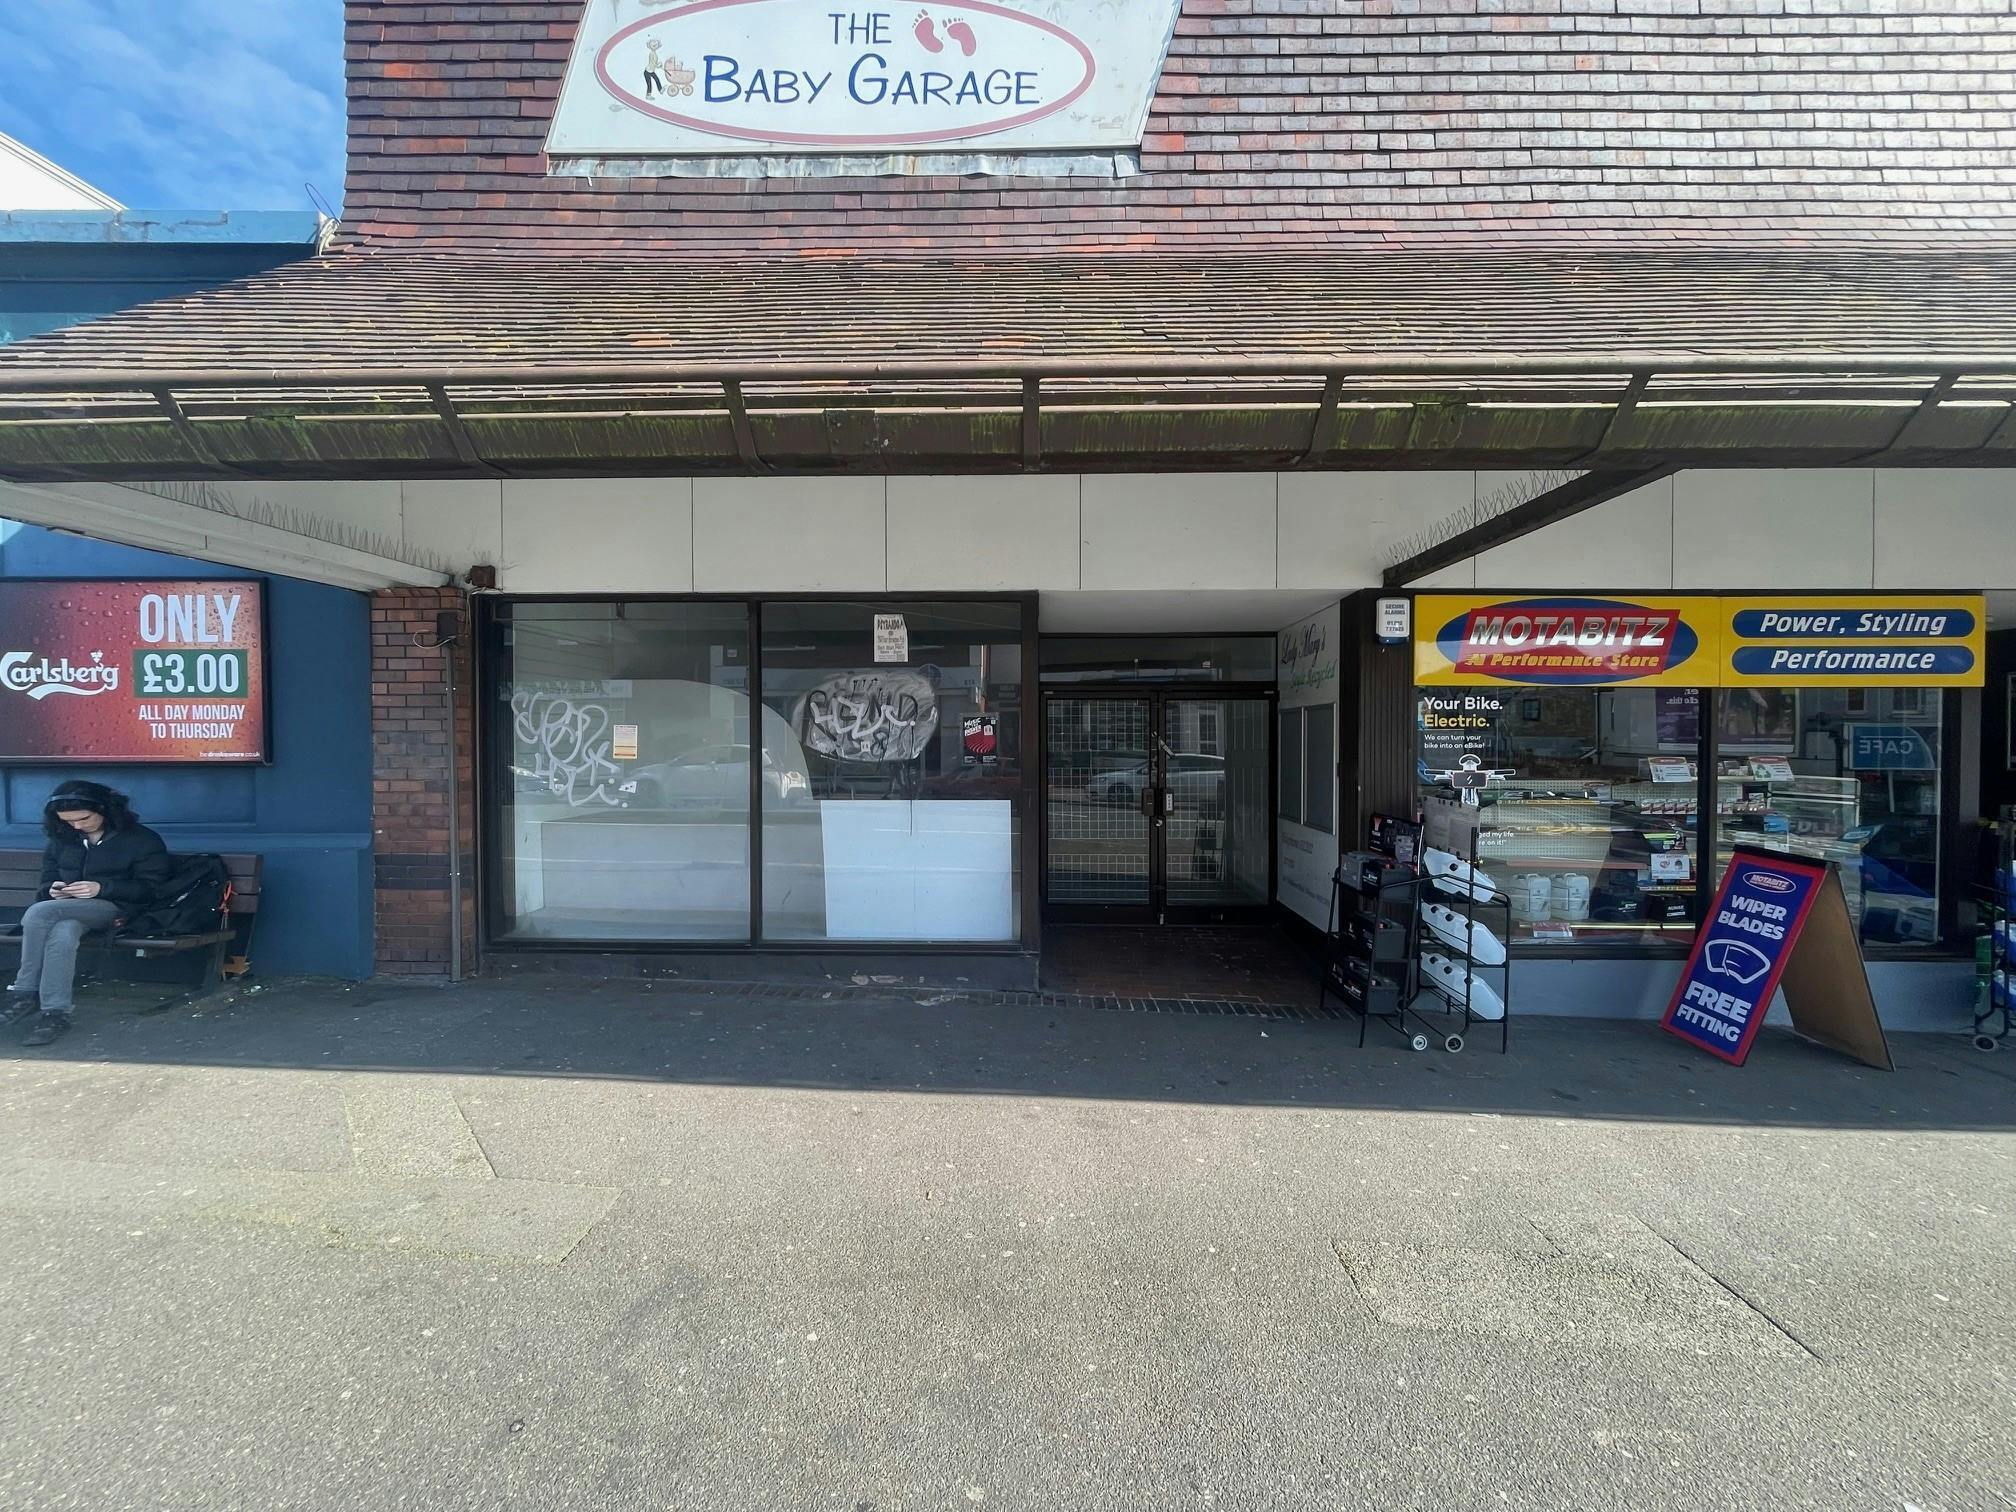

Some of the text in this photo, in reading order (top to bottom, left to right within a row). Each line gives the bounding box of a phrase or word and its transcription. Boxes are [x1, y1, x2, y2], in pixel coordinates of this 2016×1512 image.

[829, 13, 891, 45] THE
[702, 53, 1041, 105] BABY GARAGE
[139, 594, 241, 643] ONLY
[1469, 616, 1670, 646] MOTABITZ
[1760, 613, 1947, 635] Power, Styling
[0, 651, 119, 691] Carlsberg
[143, 653, 239, 693] £3.00
[1490, 653, 1602, 667] Performance
[1611, 653, 1660, 667] Store
[1770, 650, 1936, 669] Performance
[138, 704, 245, 721] ALL DAY MONDAY
[1424, 696, 1503, 710] Your Bike.
[150, 722, 234, 739] TO THURSDAY
[1424, 714, 1490, 727] Electric.
[1731, 894, 1787, 922] WIPER
[1718, 910, 1785, 940] BLADES
[1684, 980, 1752, 1024] FREE
[1677, 1004, 1741, 1042] FITTING
